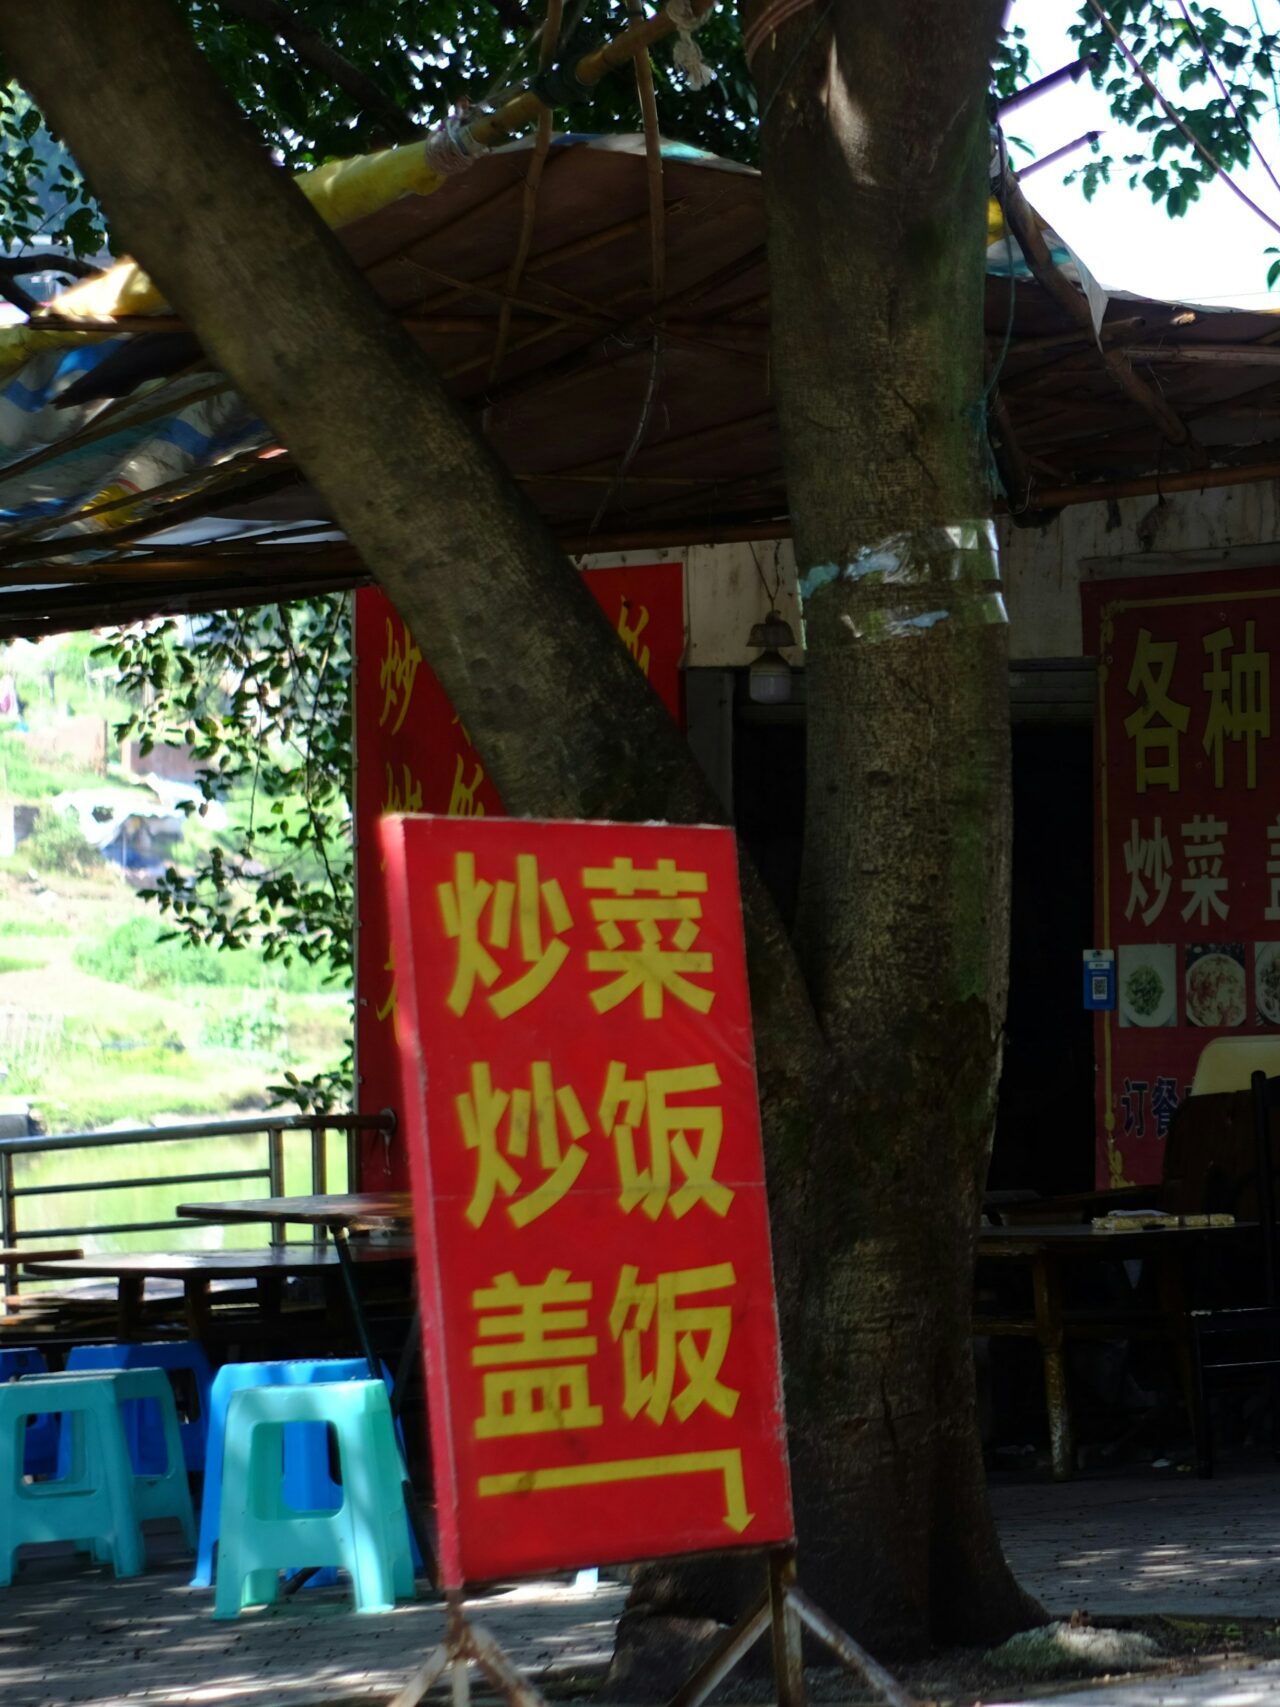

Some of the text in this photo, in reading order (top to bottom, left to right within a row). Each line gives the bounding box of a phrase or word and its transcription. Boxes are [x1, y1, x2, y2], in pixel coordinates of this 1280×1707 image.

[435, 851, 716, 1020] 炒菜
[1123, 814, 1230, 927] 炒菜
[454, 1060, 736, 1230] 炒饭
[1120, 1075, 1194, 1140] 订餐
[471, 1261, 742, 1441] 盖饭
